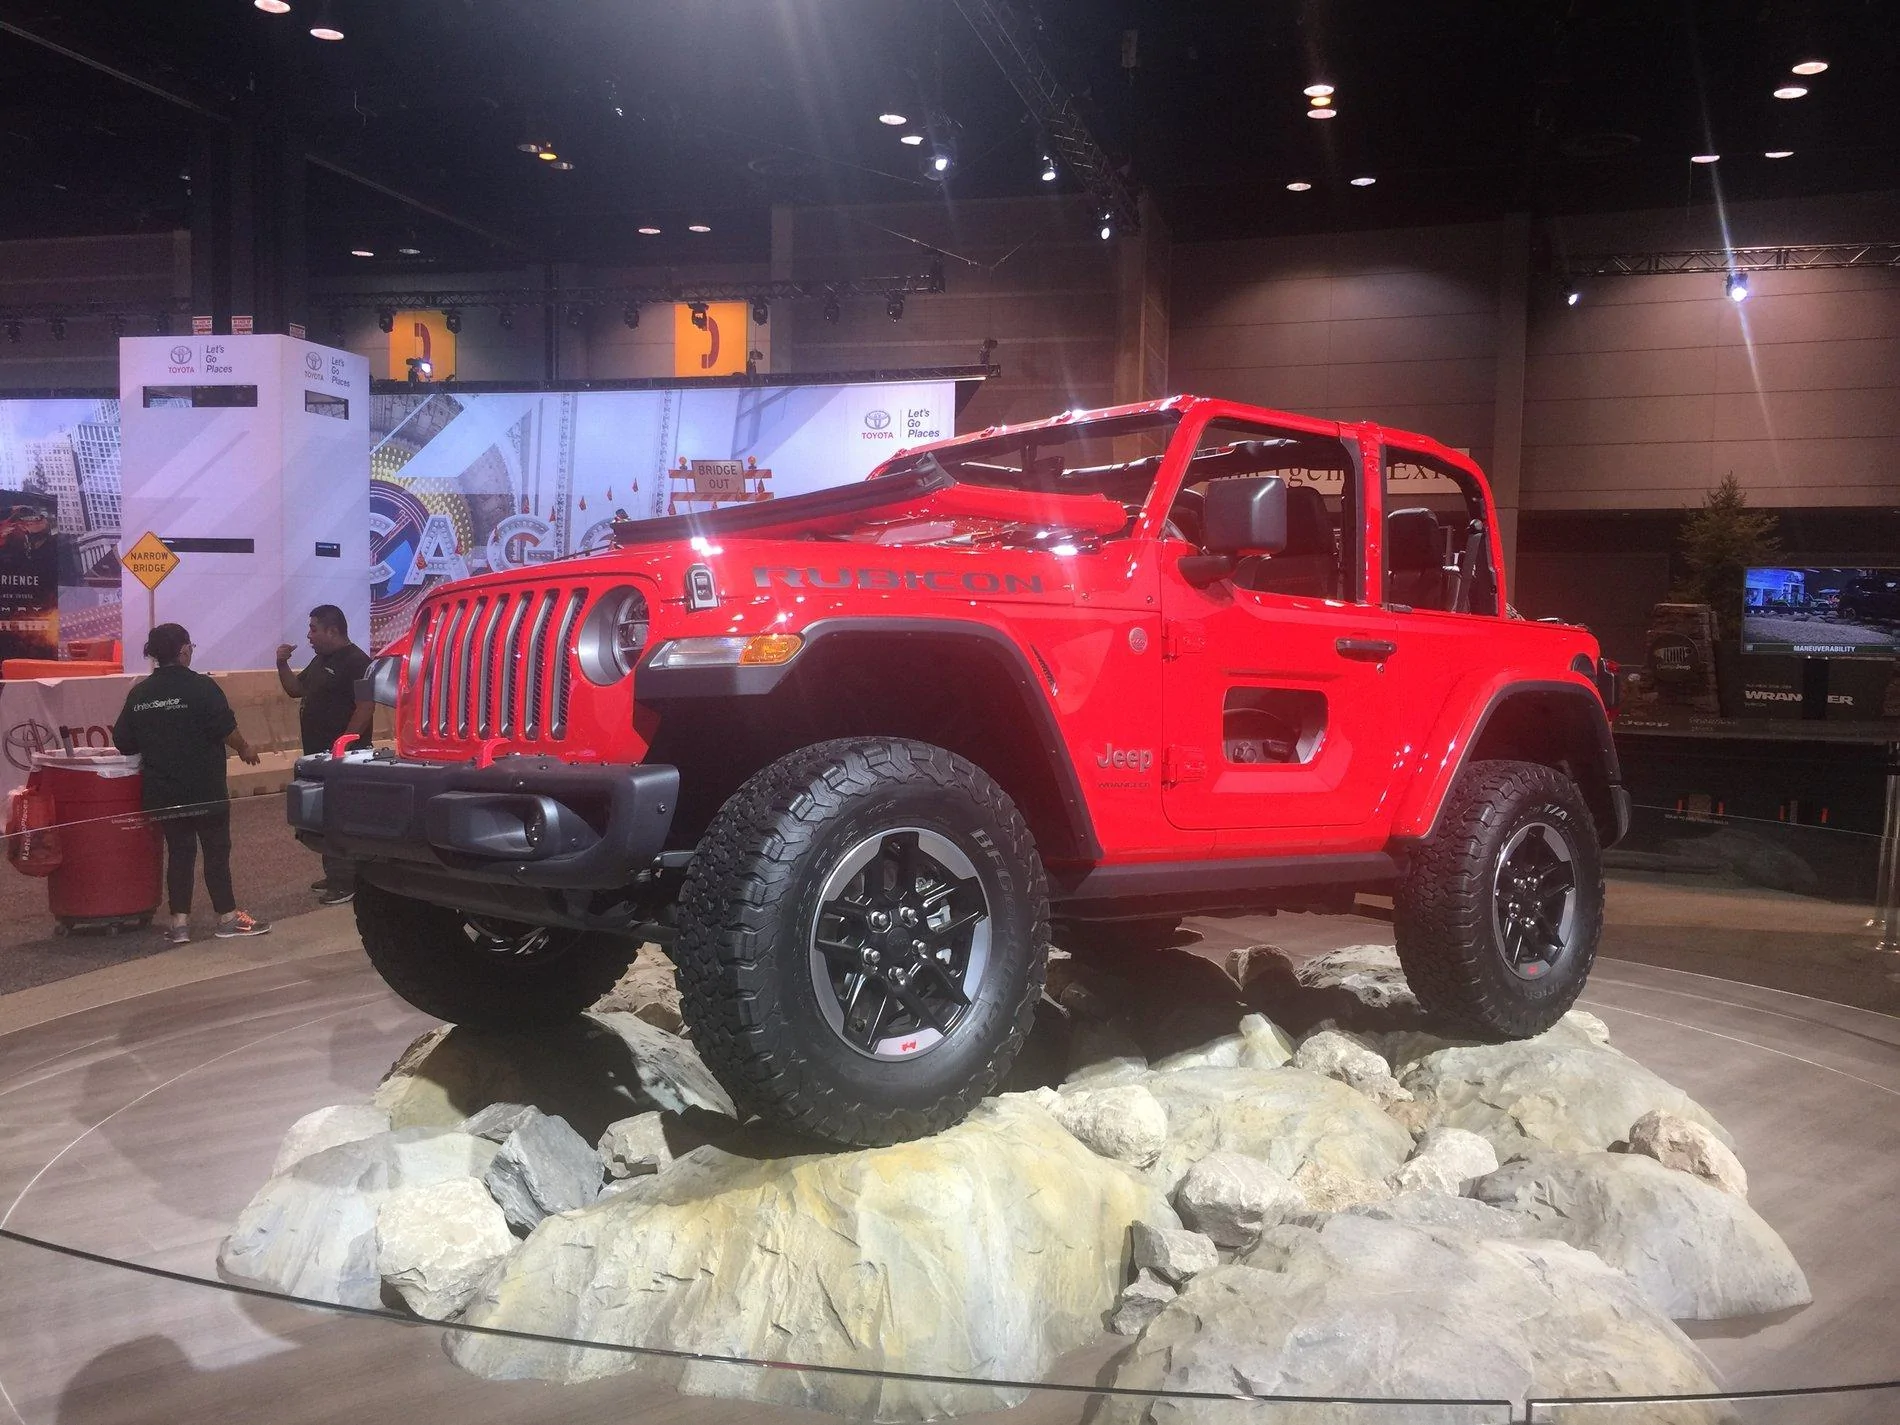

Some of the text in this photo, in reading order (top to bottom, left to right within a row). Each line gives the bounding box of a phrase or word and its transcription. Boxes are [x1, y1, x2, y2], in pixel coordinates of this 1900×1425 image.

[206, 345, 225, 354] Let's
[205, 355, 217, 363] Go
[168, 366, 195, 374] TOYOTA
[206, 365, 233, 374] Places
[331, 366, 340, 375] Go
[304, 371, 325, 382] TOYOTA
[331, 375, 350, 387] Places
[907, 409, 930, 418] Let's
[907, 419, 921, 428] Go
[862, 432, 894, 440] TOYOTA
[907, 429, 940, 438] Places
[698, 465, 738, 476] BRIDGE
[708, 479, 731, 490] OUT
[130, 552, 169, 561] NARROW
[133, 564, 166, 573] BRIDGE
[1, 575, 39, 586] RIENCE
[753, 566, 1044, 593] RUBICON
[1793, 645, 1856, 653] MANEUVERABILITY
[1096, 743, 1153, 773] Jeep
